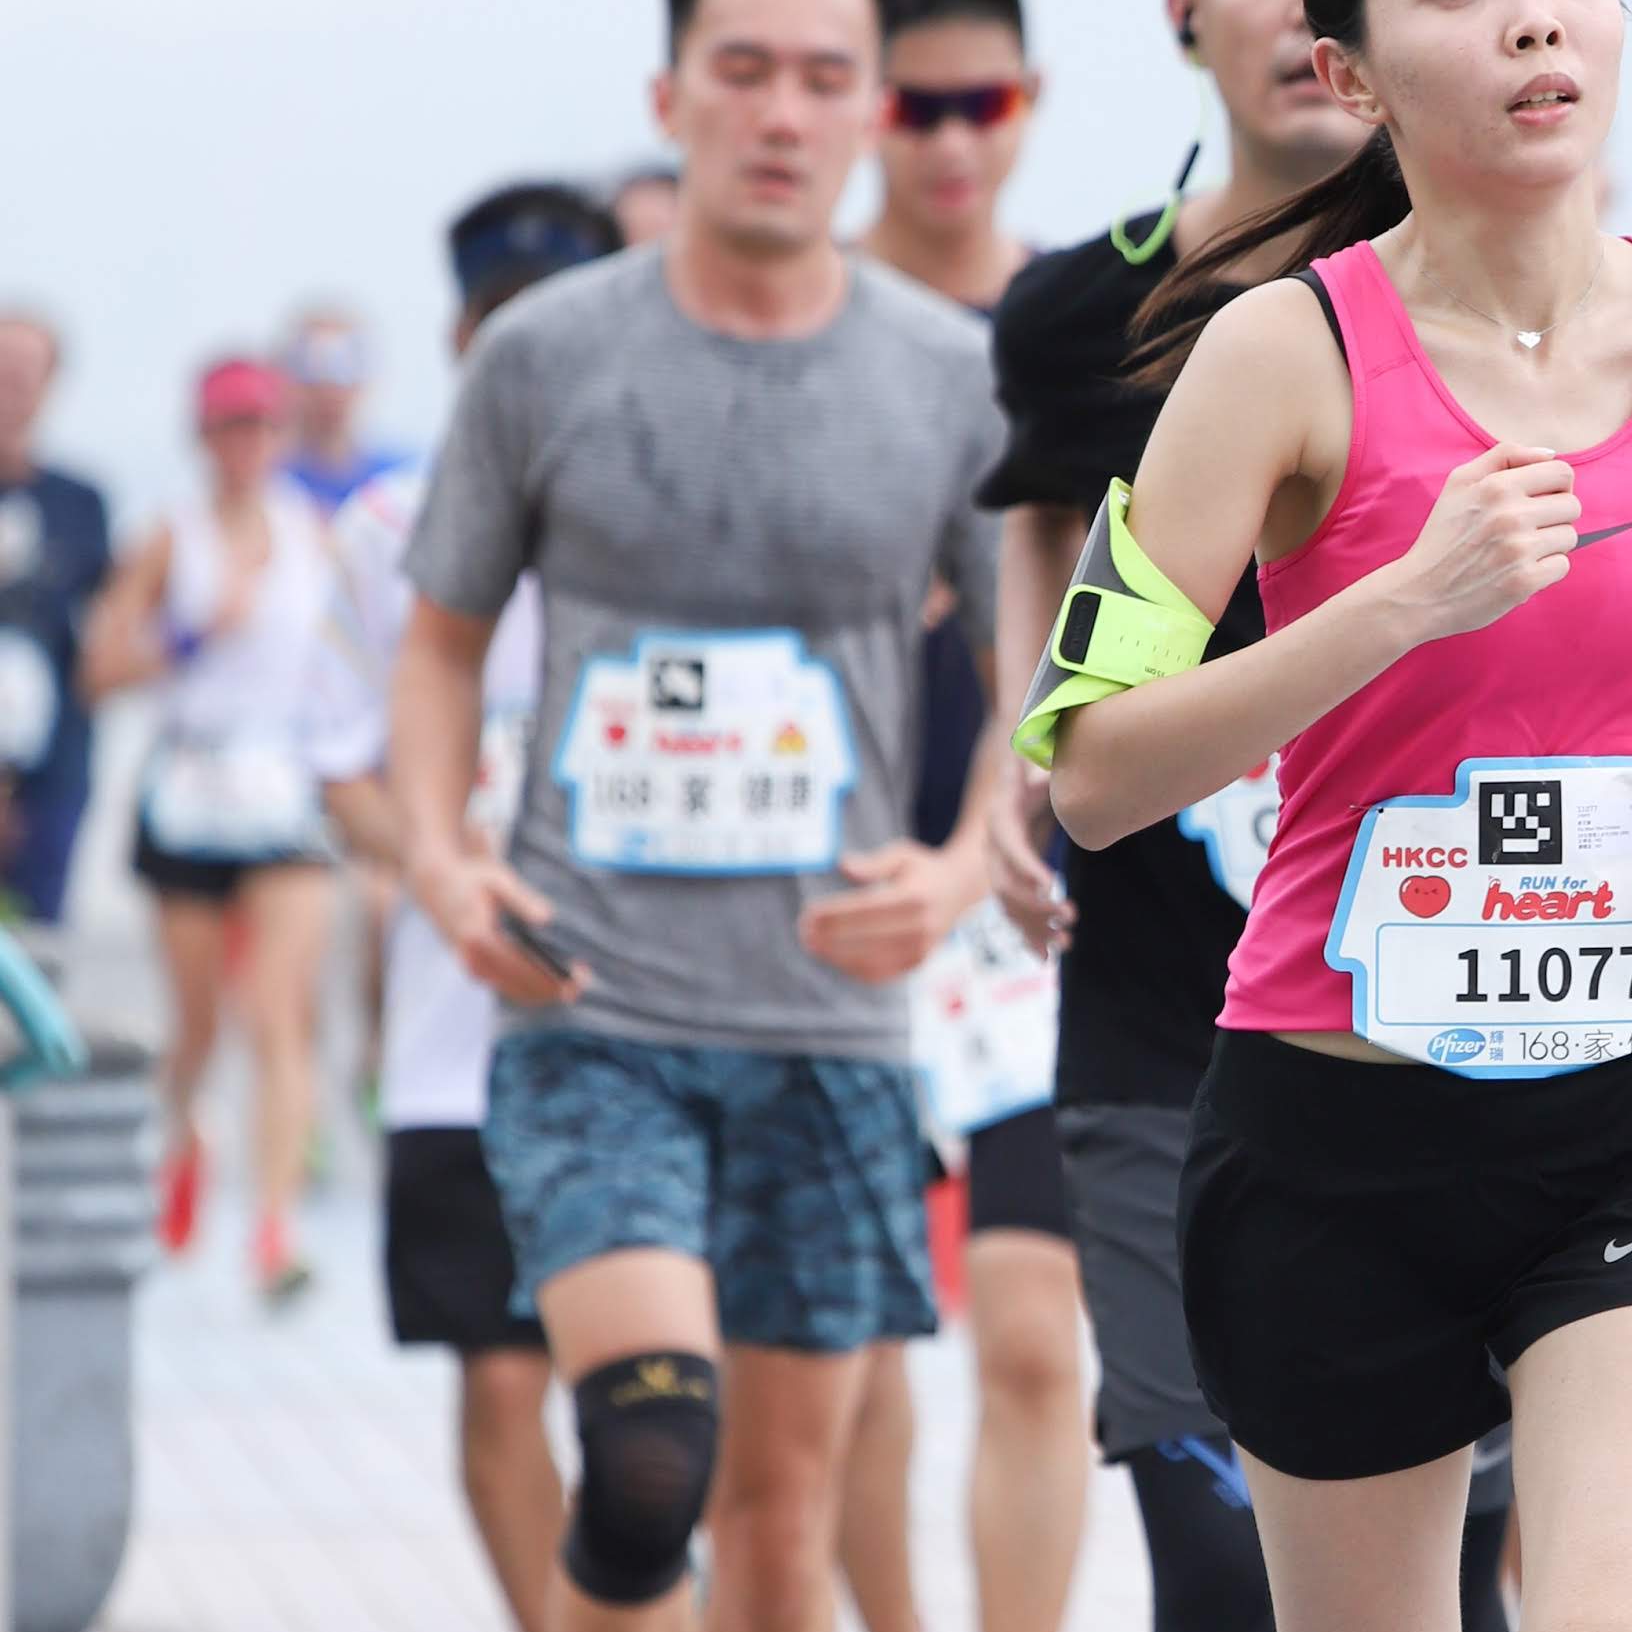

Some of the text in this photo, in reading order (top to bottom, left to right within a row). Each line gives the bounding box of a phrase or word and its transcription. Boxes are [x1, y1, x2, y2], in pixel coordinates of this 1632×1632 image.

[1383, 847, 1467, 868] HKCC
[1519, 876, 1588, 890] RUN for
[1481, 879, 1614, 920] heart
[1431, 1032, 1485, 1063] Pfizer
